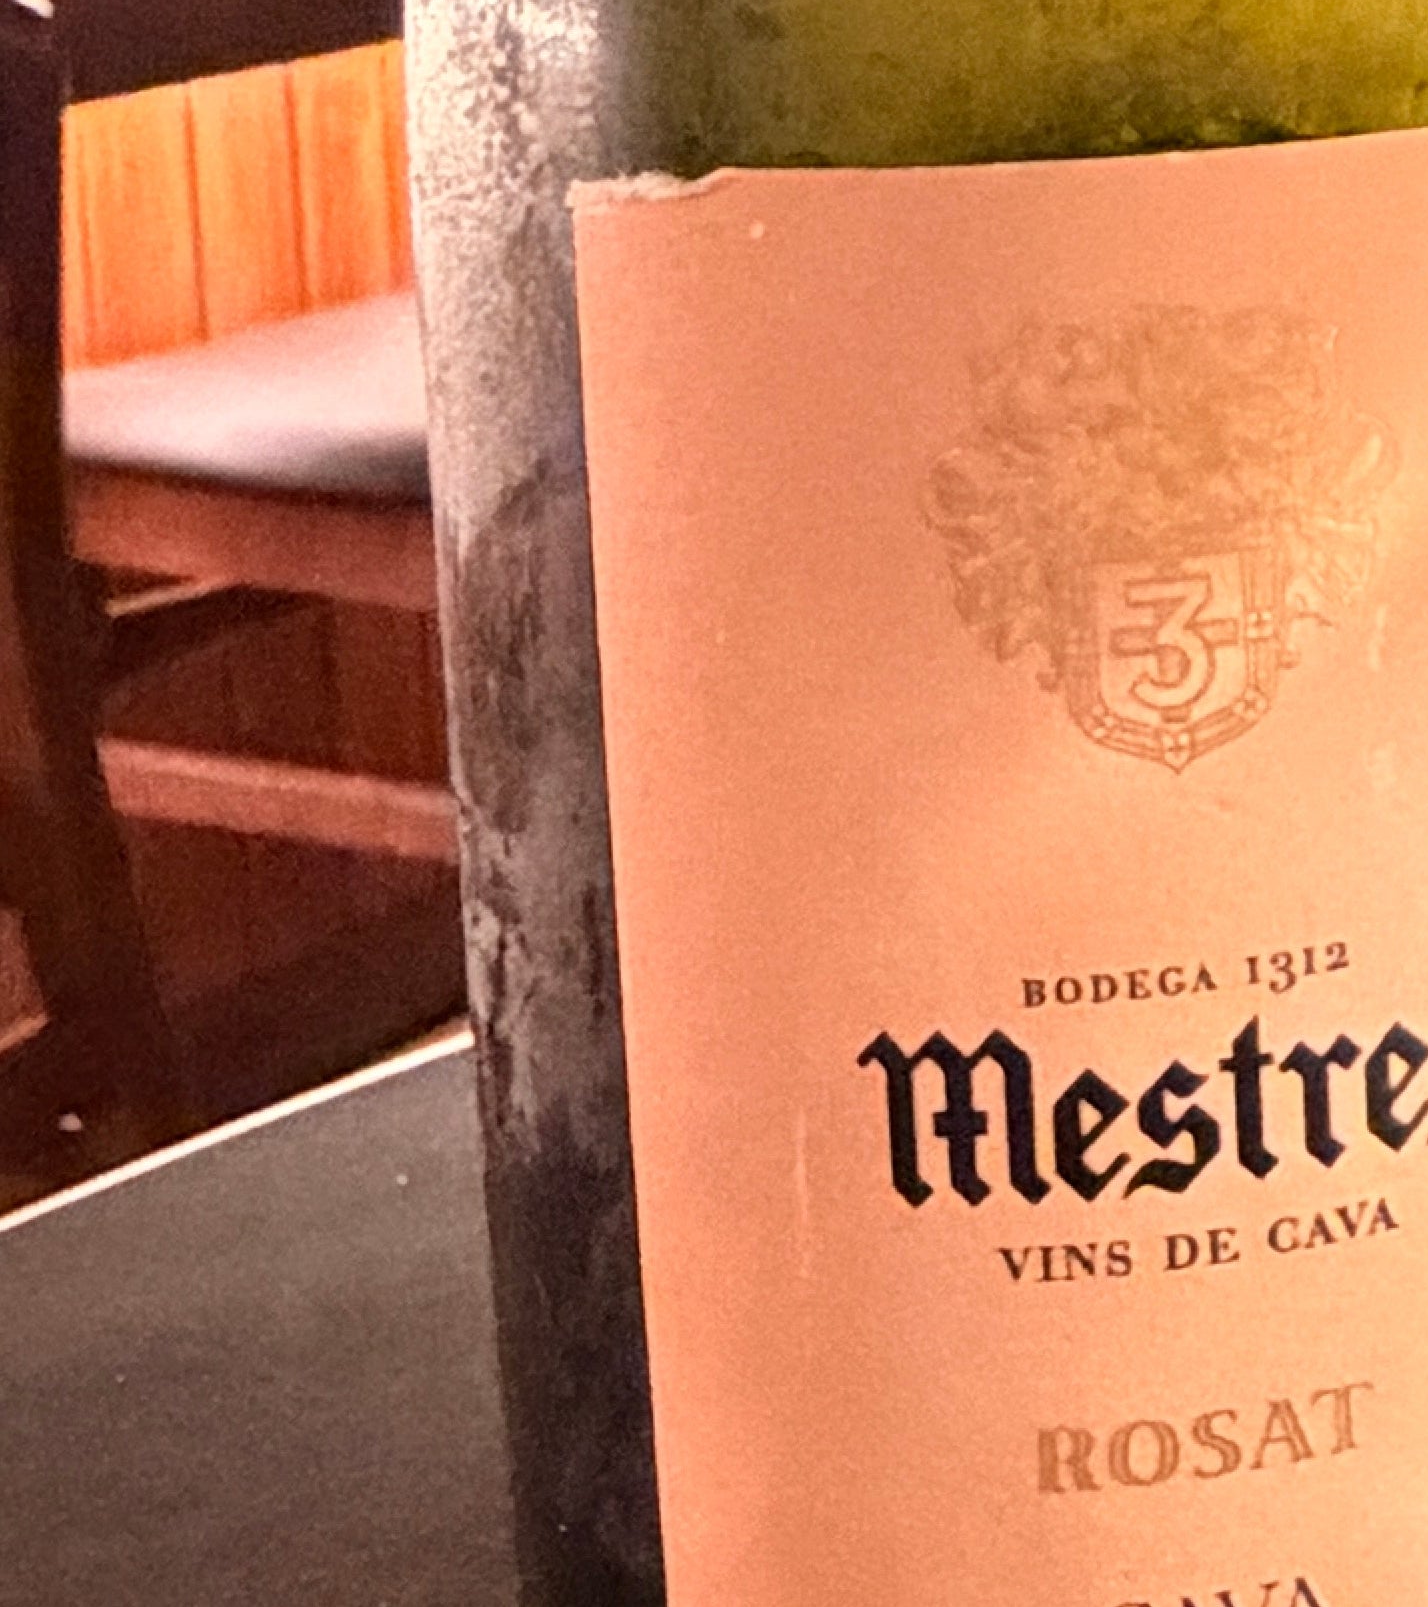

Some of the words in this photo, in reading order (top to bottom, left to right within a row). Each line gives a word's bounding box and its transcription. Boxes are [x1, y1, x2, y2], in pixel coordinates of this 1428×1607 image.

[1021, 961, 1218, 1008] BODEGA
[1246, 941, 1350, 994] 1312
[994, 1239, 1133, 1283] VINS
[1164, 1226, 1241, 1271] DE
[1266, 1197, 1400, 1254] CAVA
[1037, 1380, 1375, 1494] ROSAT
